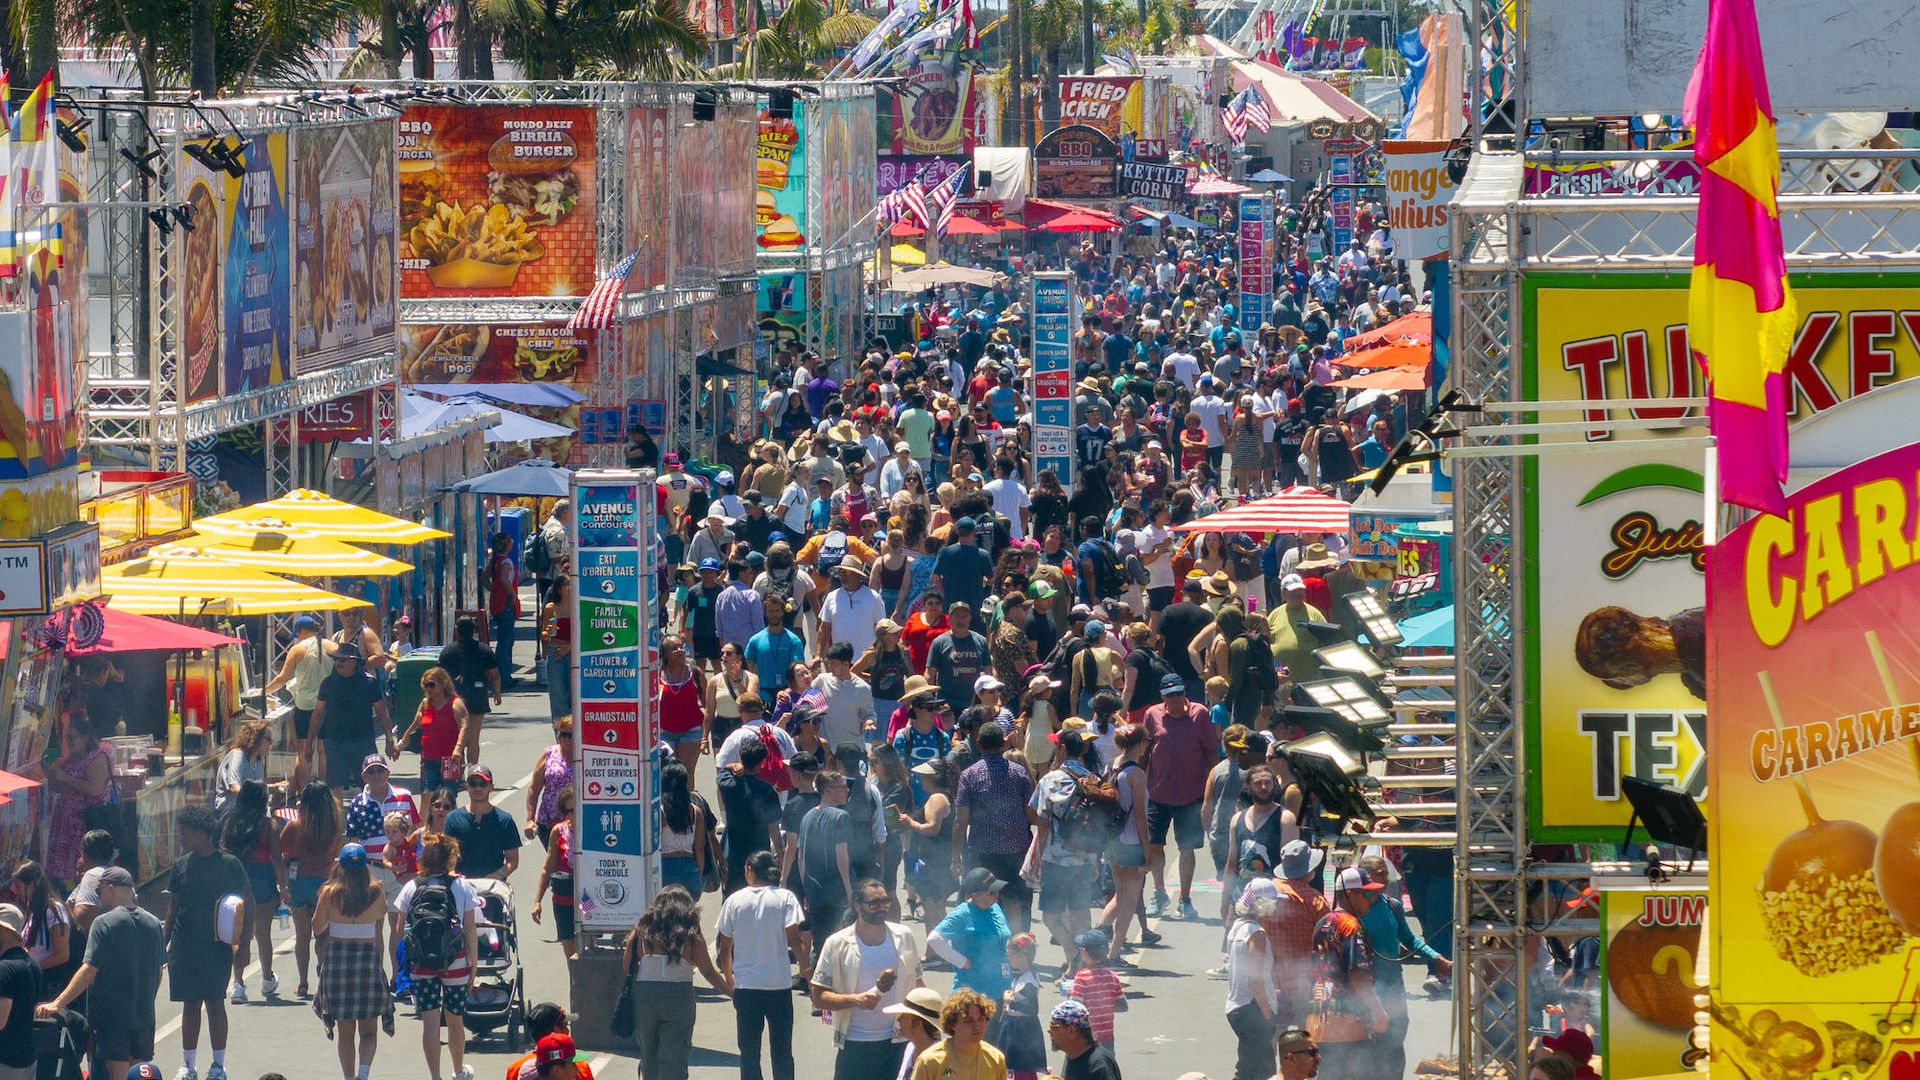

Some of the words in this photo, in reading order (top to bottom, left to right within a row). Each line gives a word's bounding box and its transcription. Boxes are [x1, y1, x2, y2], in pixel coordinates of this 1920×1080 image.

[1070, 81, 1127, 102] FRIED
[400, 121, 433, 136] BBQ
[503, 120, 543, 130] MONDO
[545, 120, 574, 130] BEEF
[510, 131, 562, 143] BIRRIA
[513, 145, 574, 158] BURGER
[1060, 142, 1092, 158] BBQ
[1123, 162, 1184, 184] KETTLE
[1131, 180, 1173, 199] CORN
[1387, 196, 1448, 229] ulius
[399, 259, 431, 270] HIP
[495, 328, 537, 338] CHEESY
[538, 328, 574, 338] BACON
[527, 339, 555, 349] CHIP
[448, 364, 473, 374] DOG
[1560, 309, 1920, 442] TUKE
[581, 504, 633, 515] AVENUE
[593, 514, 603, 522] at
[604, 514, 622, 522] the
[581, 521, 634, 529] Concourse
[599, 555, 617, 565] EXIT
[1745, 470, 1920, 648] CAR
[582, 566, 613, 576] O'BRIEN
[615, 566, 635, 576] GATE
[594, 606, 623, 617] FAMILY
[590, 618, 628, 629] FUNVILLE
[590, 656, 621, 666] FLOWER
[622, 656, 628, 666] &
[583, 667, 613, 678] GARDEN
[614, 667, 636, 678] SHOW
[584, 711, 637, 723] GRANDSTAND
[367, 755, 381, 764] USA
[592, 757, 611, 767] FIRST
[612, 757, 623, 767] AID
[624, 757, 630, 767] &
[584, 768, 606, 778] GUEST
[607, 768, 638, 778] SERVICES
[599, 859, 626, 868] TODAY'S
[595, 868, 630, 878] SCHEDULE
